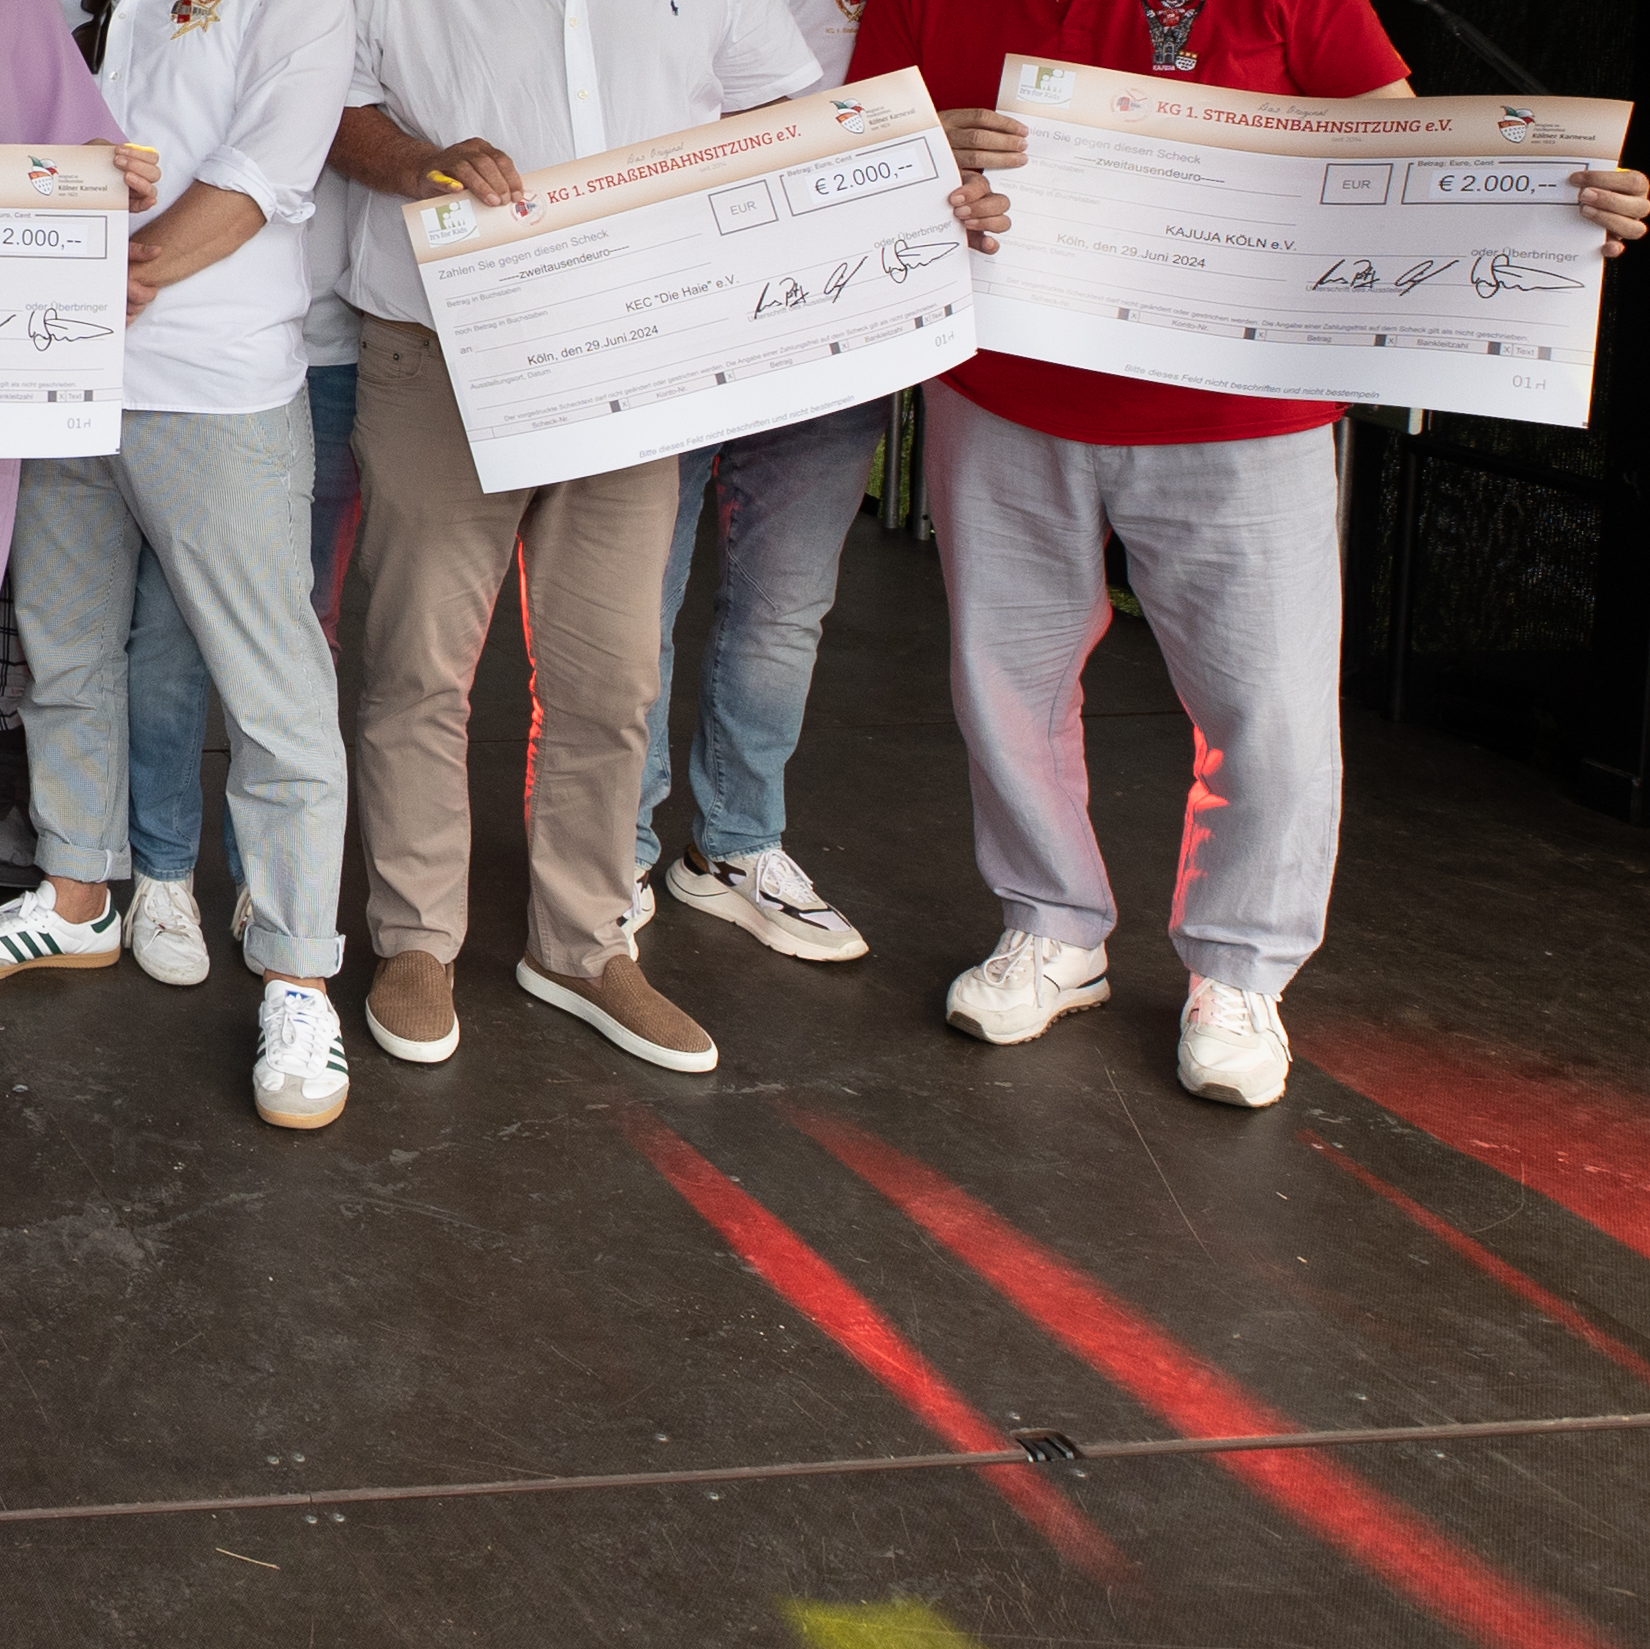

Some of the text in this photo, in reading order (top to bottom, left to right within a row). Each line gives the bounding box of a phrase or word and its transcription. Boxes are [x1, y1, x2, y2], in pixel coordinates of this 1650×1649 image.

[1157, 101, 1453, 134] KG 1. STRAßENBAHNSITZUNG e.V.
[546, 124, 802, 204] KG 1. STRAßENBAHNSITZUNG e.V.
[814, 161, 913, 196] € 2.000,--
[1438, 174, 1557, 195] € 2.000,--
[2, 227, 82, 249] 2.000,--
[1165, 225, 1297, 251] KAJUJA KÖLN e.V.
[625, 274, 739, 313] KEC "Die Haie" e.V.
[526, 324, 659, 366] Köln, den 29.Juni.2024
